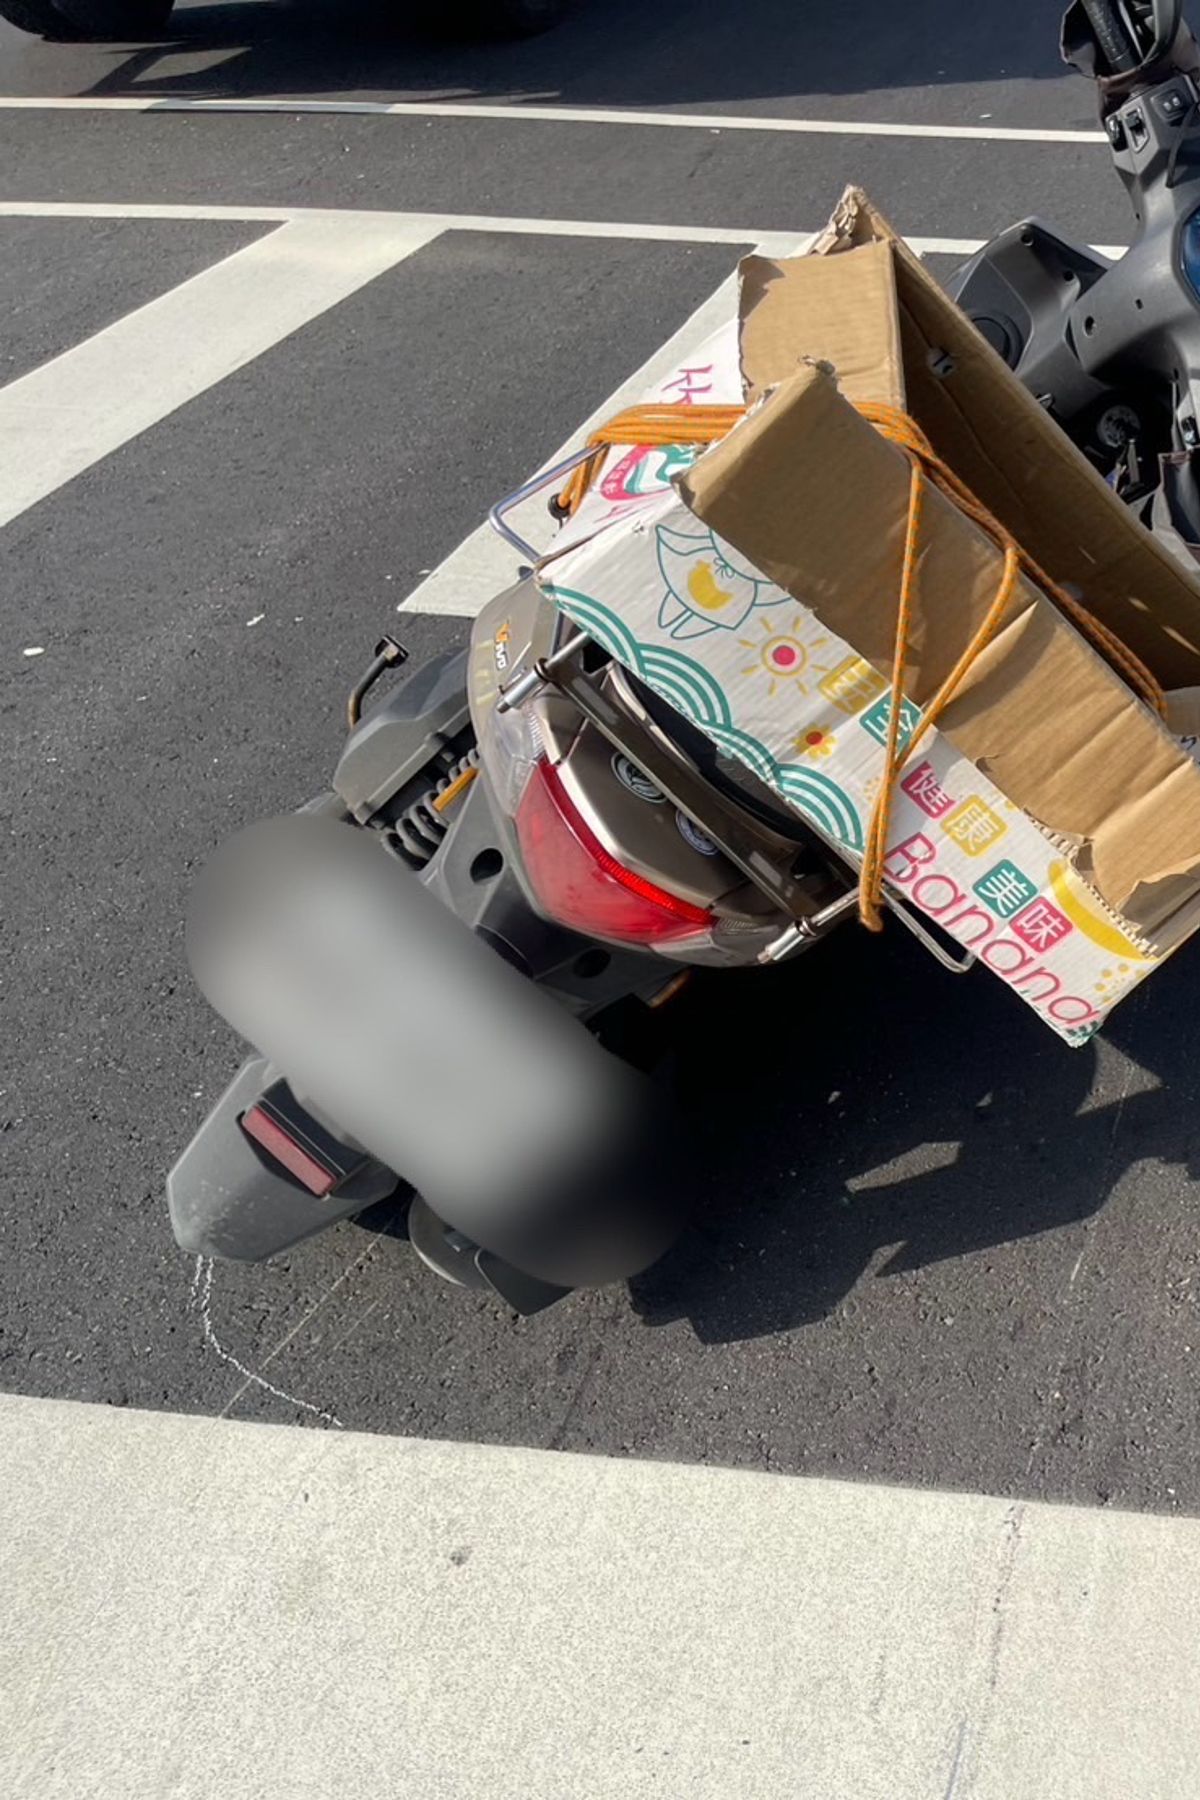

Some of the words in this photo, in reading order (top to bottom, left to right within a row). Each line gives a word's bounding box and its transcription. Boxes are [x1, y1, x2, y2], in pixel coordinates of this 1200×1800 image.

[884, 832, 1100, 1026] Banana
[906, 763, 1002, 853] 健康
[976, 866, 1068, 950] 美味
